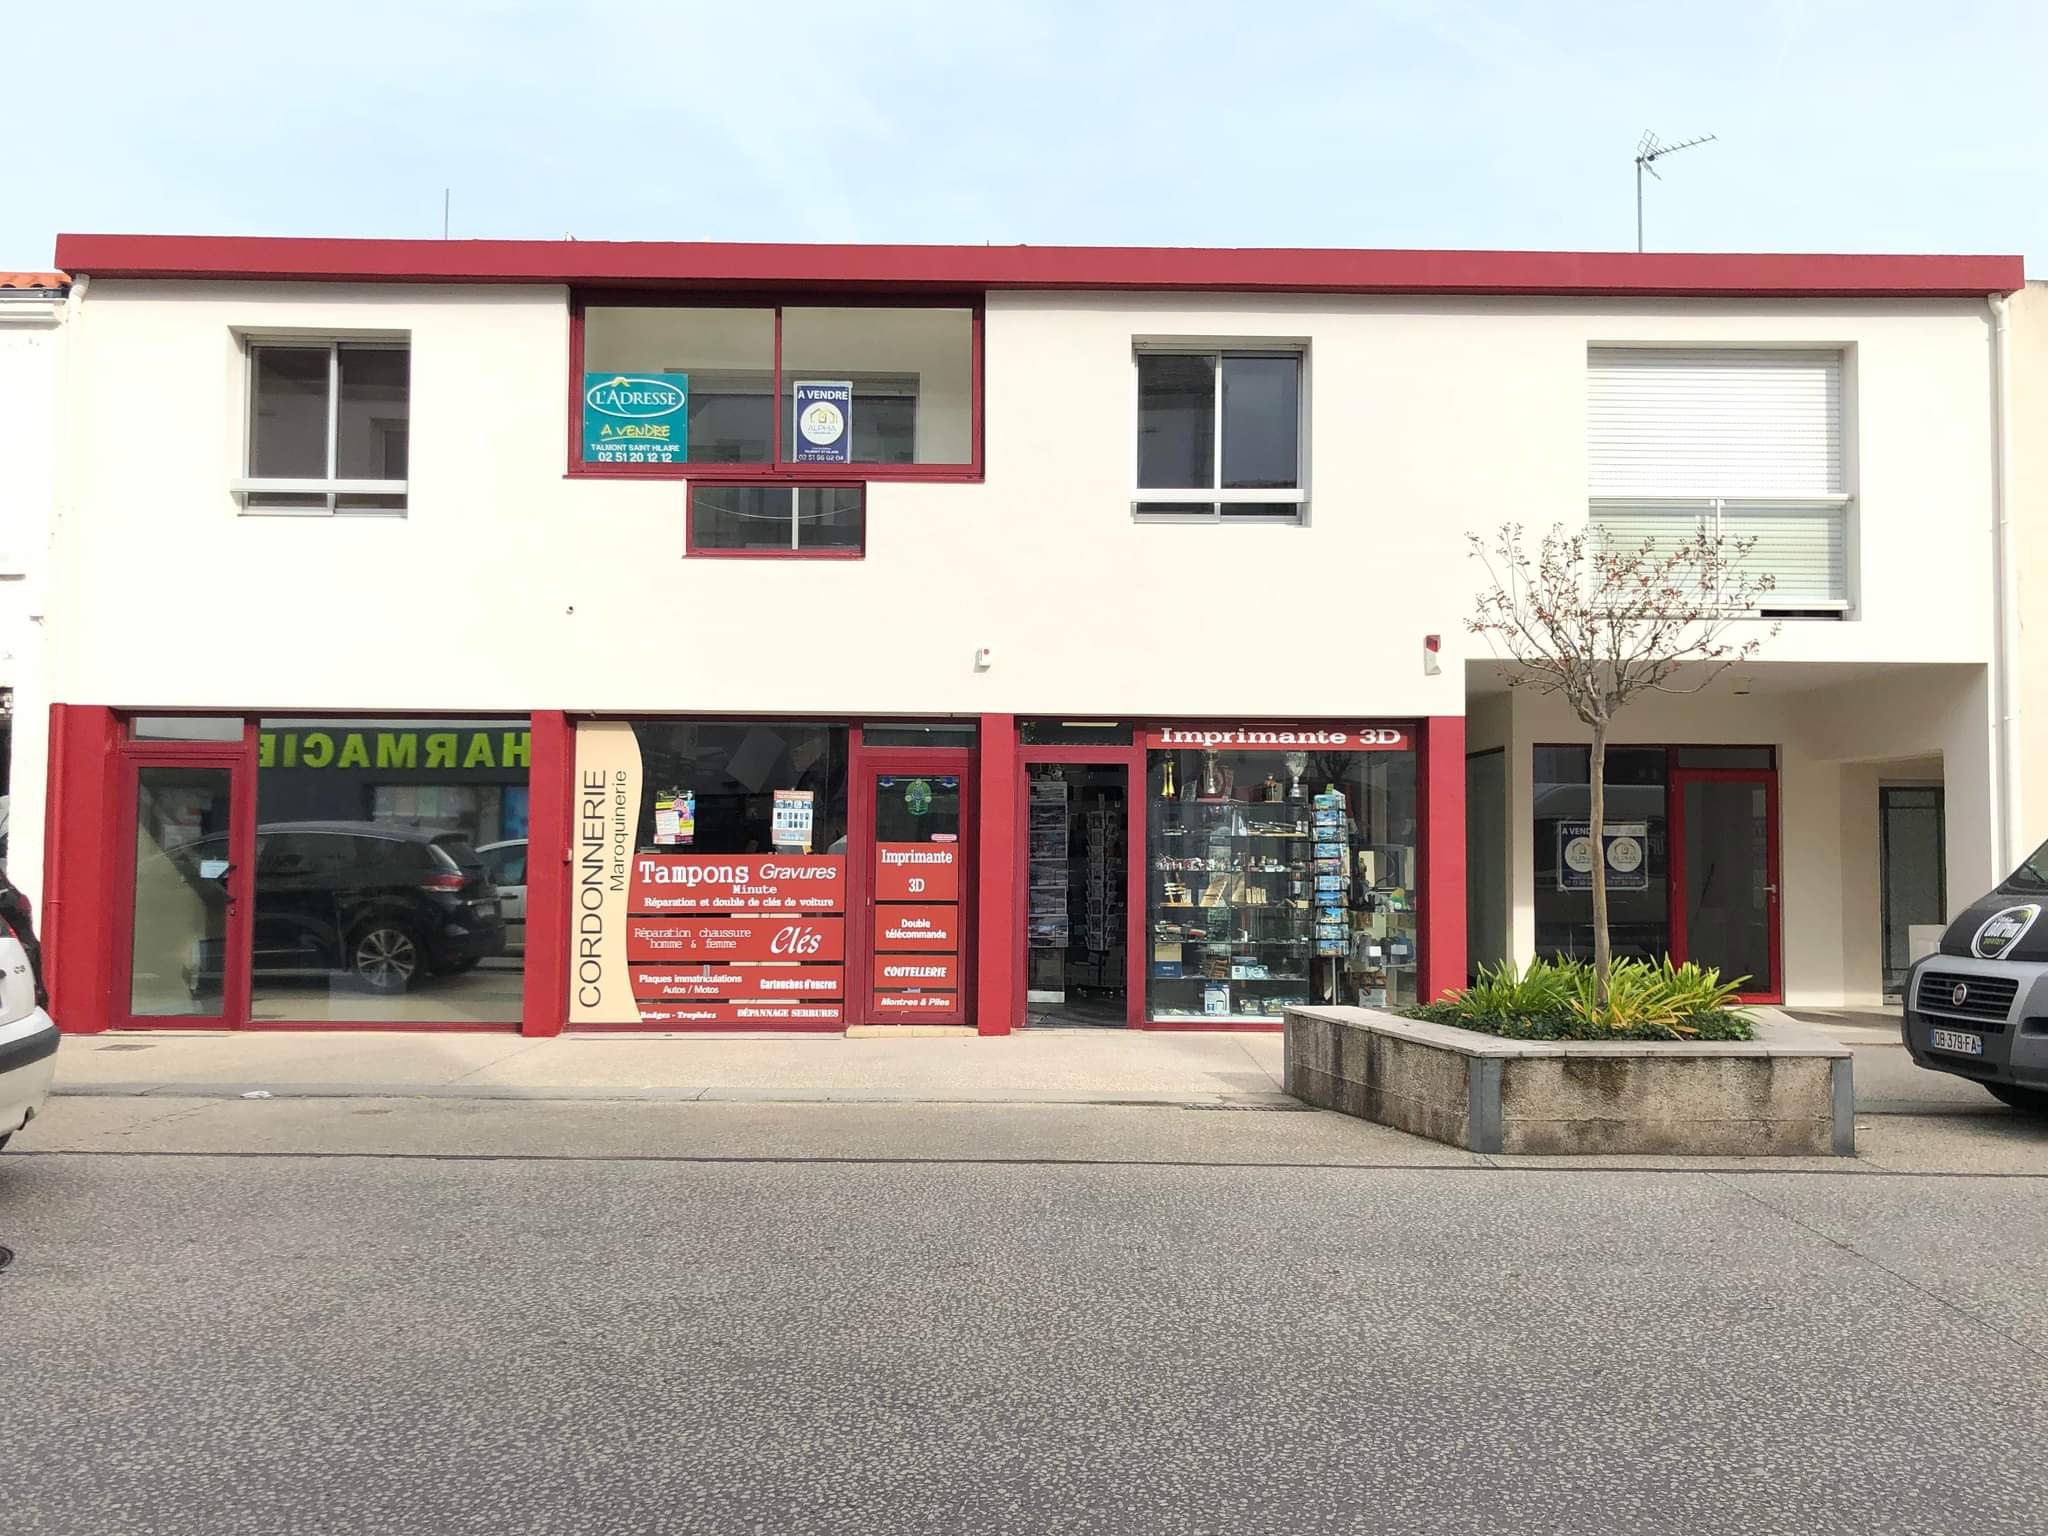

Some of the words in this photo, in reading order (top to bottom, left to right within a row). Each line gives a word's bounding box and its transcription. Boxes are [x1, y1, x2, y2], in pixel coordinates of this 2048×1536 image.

[798, 390, 806, 400] A
[807, 390, 849, 401] VENDRE
[601, 424, 613, 436] A
[808, 424, 837, 432] ALPHA
[591, 444, 627, 452] TALMONT
[629, 444, 652, 452] SAINT
[598, 452, 613, 463] 02
[616, 452, 628, 463] 51
[629, 452, 644, 463] 20
[647, 452, 658, 463] 12
[661, 452, 673, 463] 12
[1161, 728, 1348, 746] Imprimante
[1359, 729, 1401, 745] 3D
[610, 770, 628, 892] Maroquinerie
[881, 849, 953, 866] Imprimante
[639, 861, 750, 887] Tampons
[759, 863, 837, 879] Gravures
[578, 770, 606, 1008] CORDONNERIE
[732, 884, 778, 895] Minute
[908, 878, 925, 893] 3D
[644, 897, 697, 908] Réparation
[699, 898, 711, 907] et
[713, 897, 745, 907] double
[747, 897, 760, 907] de
[763, 897, 782, 907] clés
[784, 897, 797, 907] de
[799, 898, 834, 908] voiture
[901, 919, 931, 929] Double
[634, 927, 692, 940] Réparation
[699, 927, 752, 938] chaussure
[885, 928, 947, 940] télécommande
[649, 939, 683, 949] homme
[690, 939, 697, 949] &
[705, 939, 737, 949] femme
[770, 926, 823, 954] Clés
[884, 966, 948, 978] COUTELLERIE
[639, 974, 673, 985] Plaques
[674, 974, 743, 984] immatriculations
[760, 979, 804, 990] Cartouches
[662, 985, 686, 994] Autos
[694, 985, 719, 994] Motos
[881, 997, 918, 1007] Montres
[919, 998, 926, 1006] &
[928, 997, 950, 1007] Piles
[640, 1011, 671, 1020] Badges
[677, 1010, 717, 1020] Trophées
[737, 1008, 789, 1018] DÉPANNAGE
[791, 1008, 839, 1018] SERRURES
